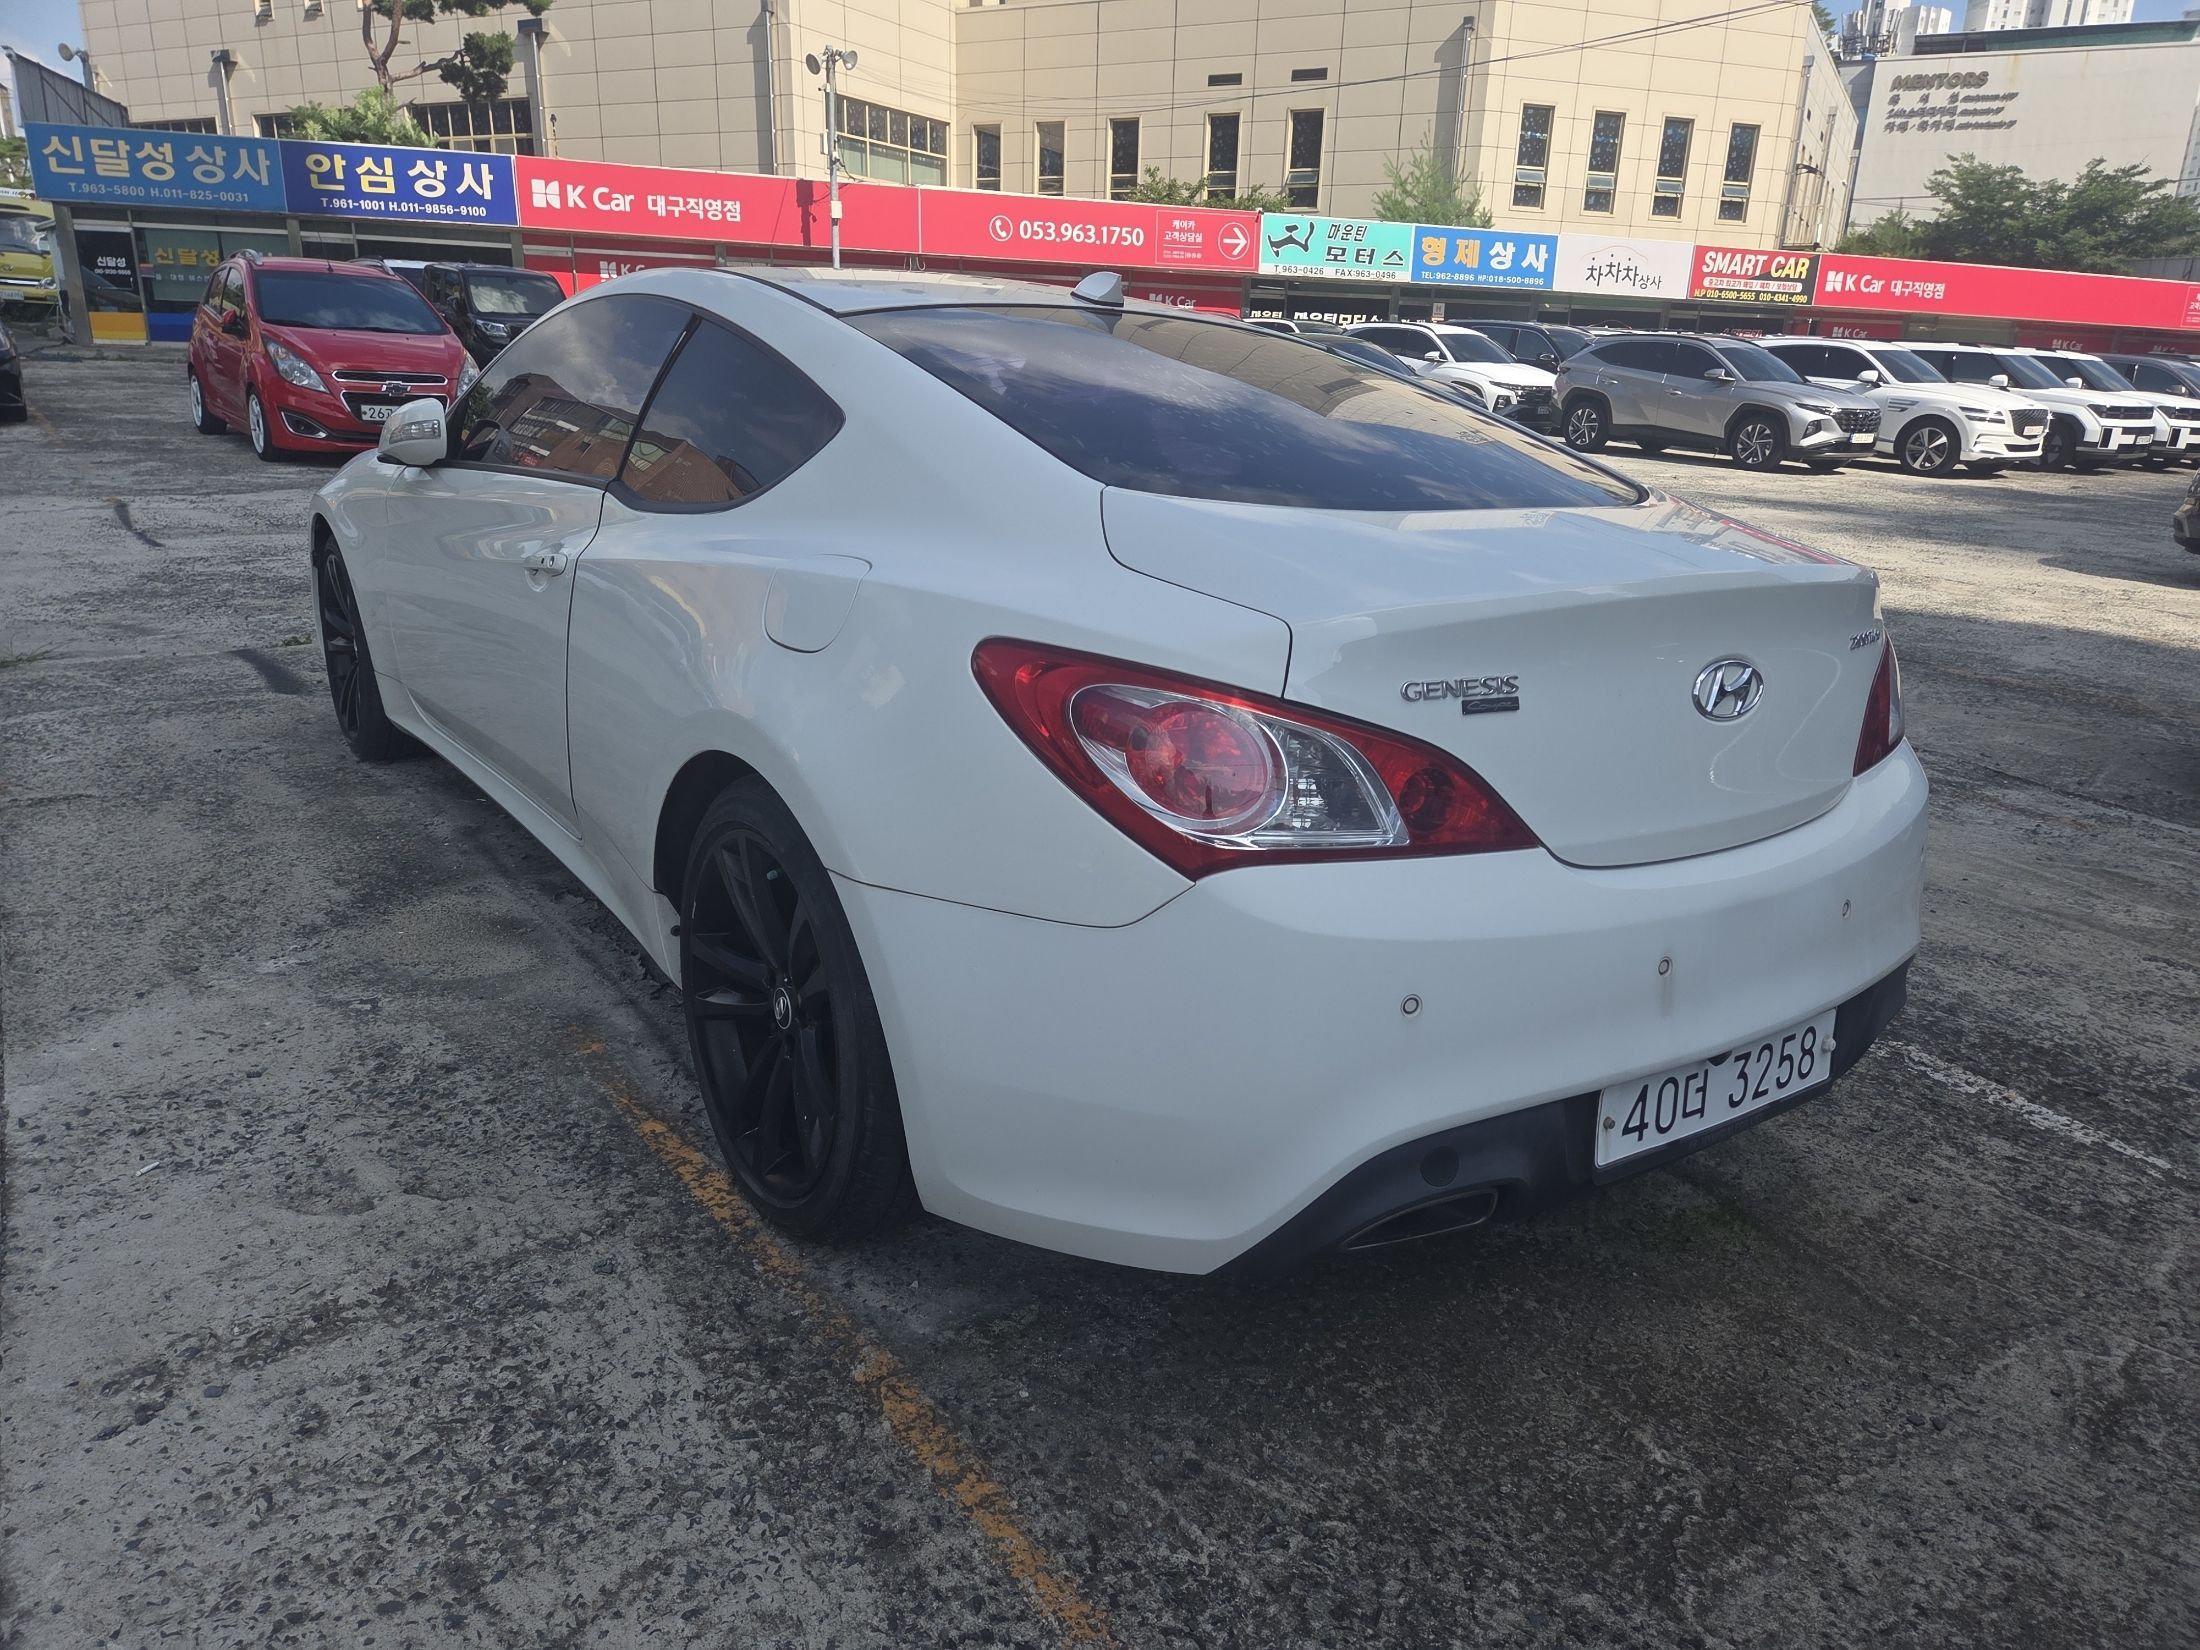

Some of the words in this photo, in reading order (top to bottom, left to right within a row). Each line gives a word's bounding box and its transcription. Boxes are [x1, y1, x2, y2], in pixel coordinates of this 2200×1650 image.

[42, 135, 175, 181] 신달성
[185, 145, 270, 186] 상사
[68, 182, 145, 197] T.963-5800
[150, 187, 249, 202] H.011-825-0031
[566, 184, 587, 209] K
[593, 186, 635, 212] Car
[647, 195, 741, 222] 대구직영점
[320, 197, 384, 211] T.961-1001
[389, 202, 487, 217] H.011-9856-9100
[1019, 219, 1145, 247] 053.963.1750
[1327, 223, 1368, 242] 마운틴
[1325, 245, 1404, 266] 모터스
[1702, 251, 1769, 277] SMART
[1770, 256, 1810, 279] CAR
[1274, 265, 1324, 275] T.963-0426
[1335, 268, 1396, 279] FAX:963-0496
[1421, 271, 1474, 281] TEL:962-8896
[1477, 275, 1544, 285] HP:018-500-8896
[1759, 292, 1808, 303] 010-4341-4990
[1845, 273, 1858, 292] K
[1860, 275, 1885, 293] Car
[1890, 280, 1945, 299] 대구직영점
[1400, 675, 1520, 702] GENESIS
[1728, 1025, 1817, 1109] 3258
